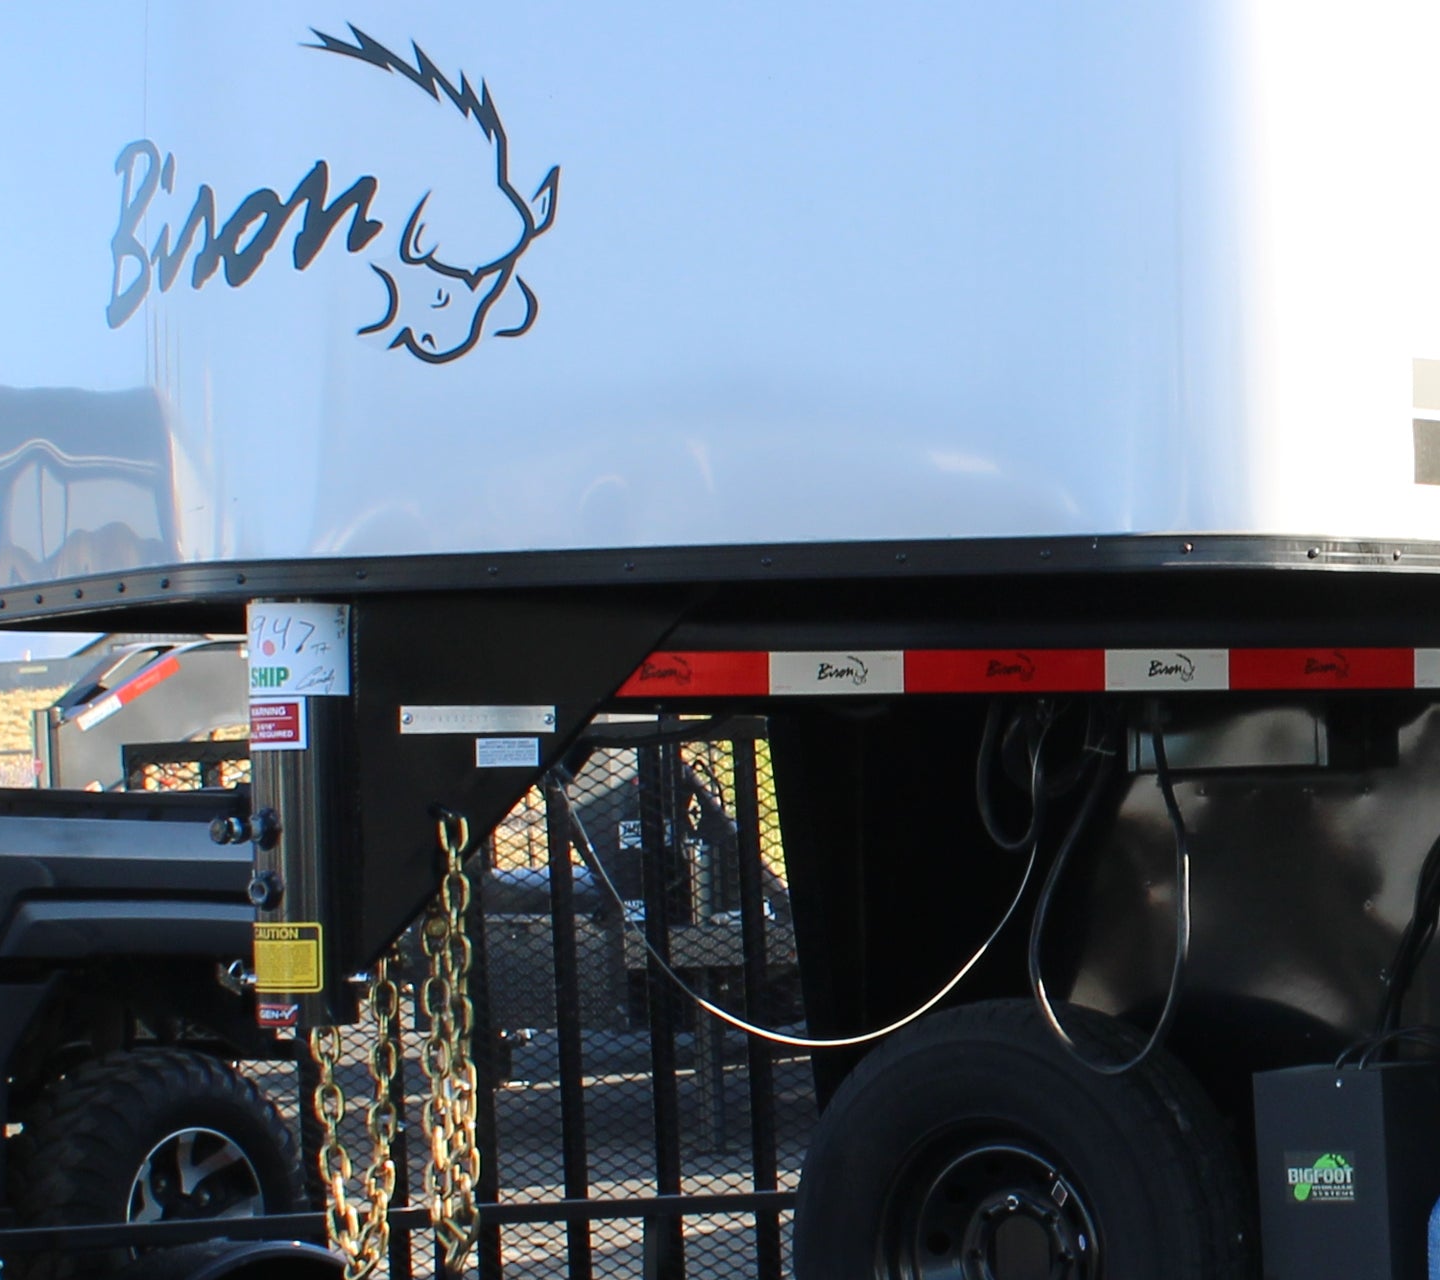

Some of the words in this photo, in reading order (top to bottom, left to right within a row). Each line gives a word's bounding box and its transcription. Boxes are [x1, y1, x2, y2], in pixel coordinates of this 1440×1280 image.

[106, 139, 383, 329] Bison
[817, 662, 855, 681] Bison
[1147, 660, 1182, 677] Bison
[1288, 1167, 1353, 1184] BIGFOOT
